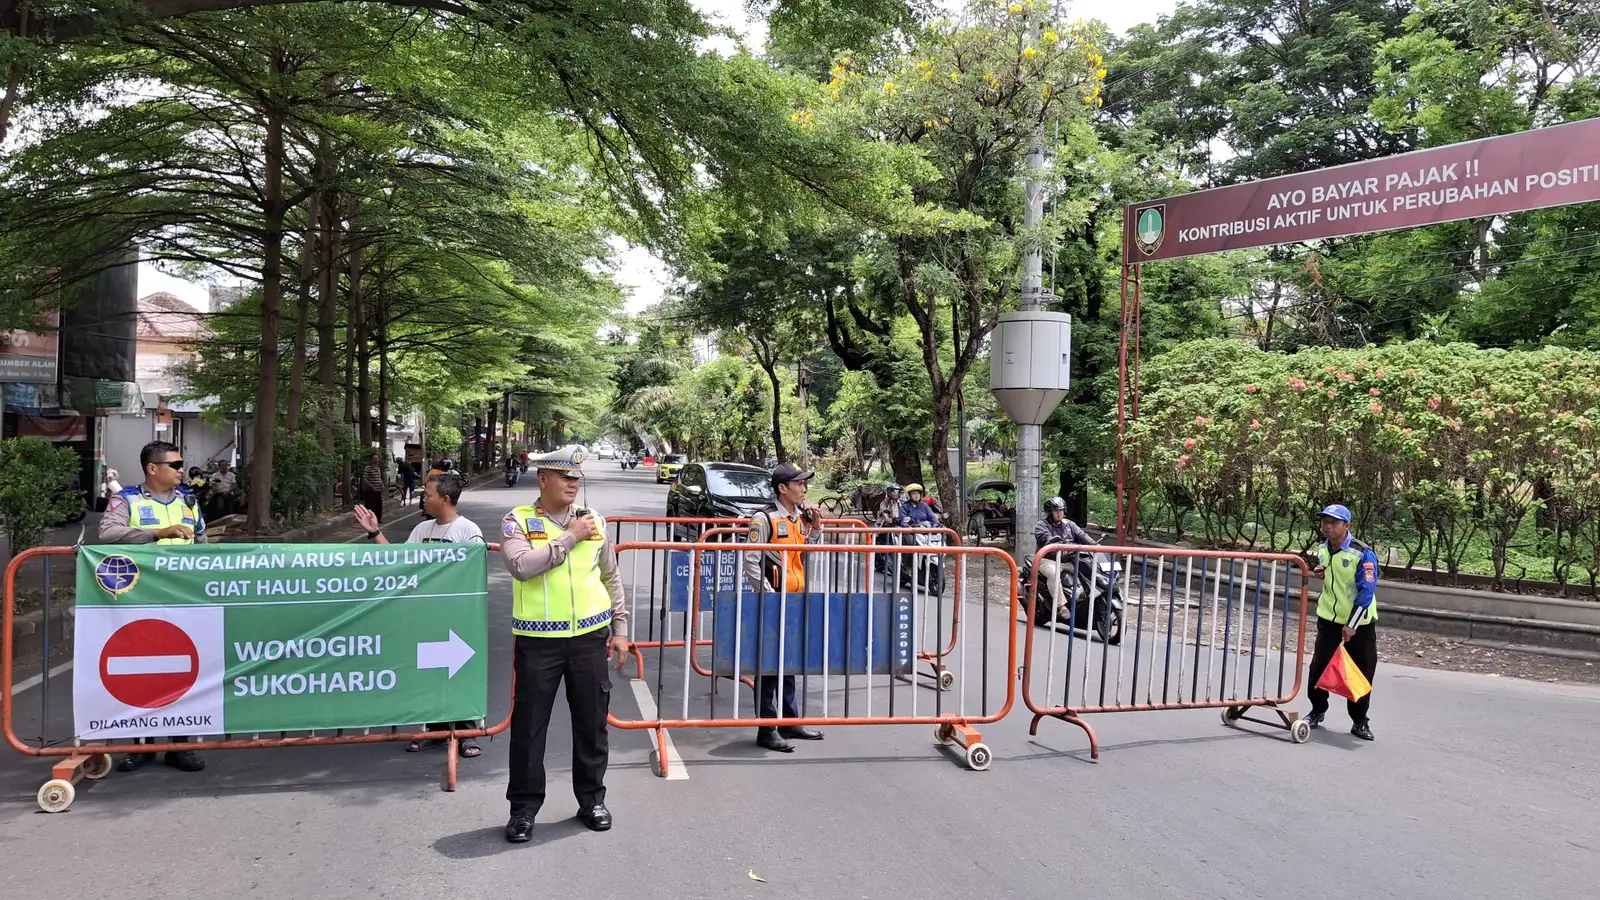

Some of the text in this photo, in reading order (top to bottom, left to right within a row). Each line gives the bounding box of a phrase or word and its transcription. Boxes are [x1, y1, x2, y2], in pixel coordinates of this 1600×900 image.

[1267, 159, 1479, 210] AYO BAYAR PAJAK !!
[1178, 217, 1270, 242] KONTRIBUSI
[1274, 209, 1321, 228] AKTIF
[1326, 198, 1388, 221] UNTUK
[1393, 177, 1518, 212] PERUBAHAN
[0, 359, 56, 368] UMBER ALAM
[154, 547, 467, 571] PENGALIHAN ARUS LALU LINTAS
[204, 574, 419, 597] GIAT HAUL SOLO 2024
[233, 635, 381, 662] WONOGIRI
[233, 669, 397, 697] SUKOHARJO
[90, 714, 212, 730] DILARANG MASUK
